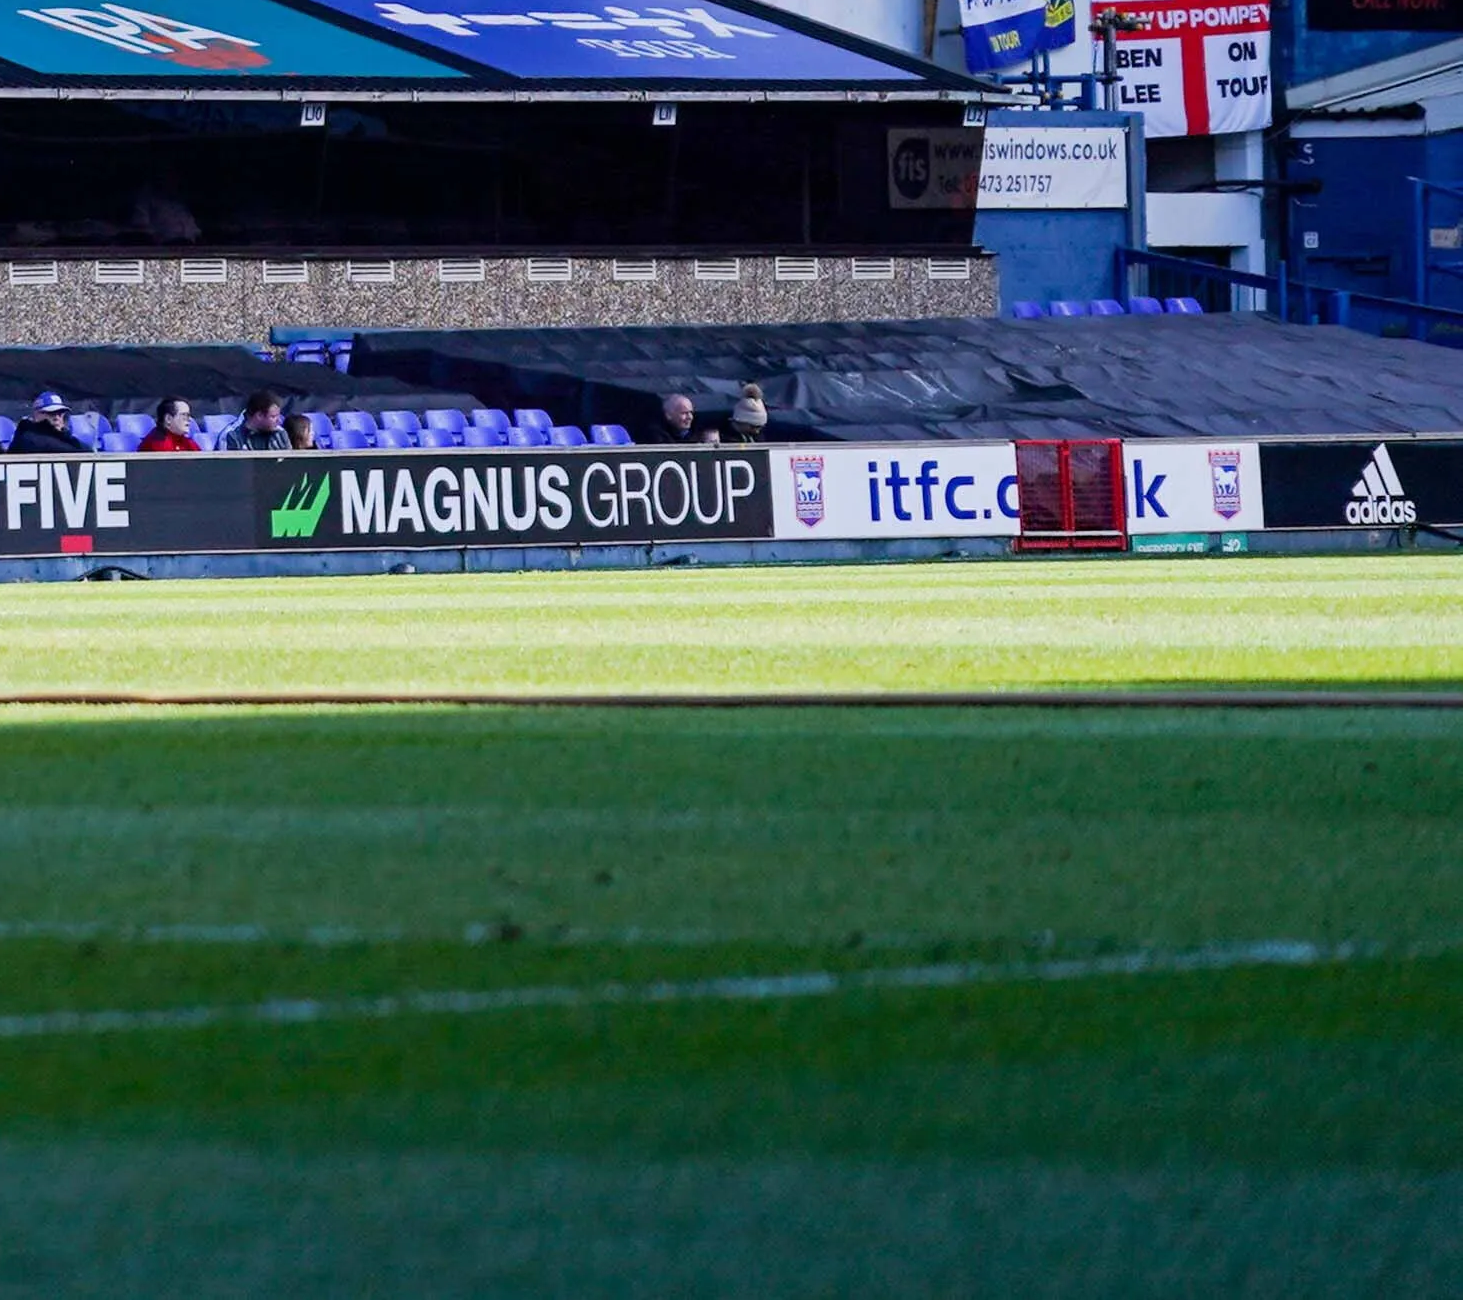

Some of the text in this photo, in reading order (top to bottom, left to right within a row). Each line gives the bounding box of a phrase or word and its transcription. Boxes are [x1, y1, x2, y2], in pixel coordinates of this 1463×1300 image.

[1153, 10, 1187, 30] UP
[1188, 3, 1268, 28] POMPEY
[17, 3, 261, 56] IPA
[577, 37, 738, 59] TOUR
[1116, 48, 1162, 69] BEN
[1229, 42, 1257, 63] ON
[1121, 84, 1161, 104] LEE
[304, 105, 322, 121] L10
[934, 139, 1117, 160] www.iswindows.co.uk
[1006, 175, 1052, 193] 251757
[343, 459, 755, 536] MAGNUS GROUP
[1347, 498, 1416, 524] adidas
